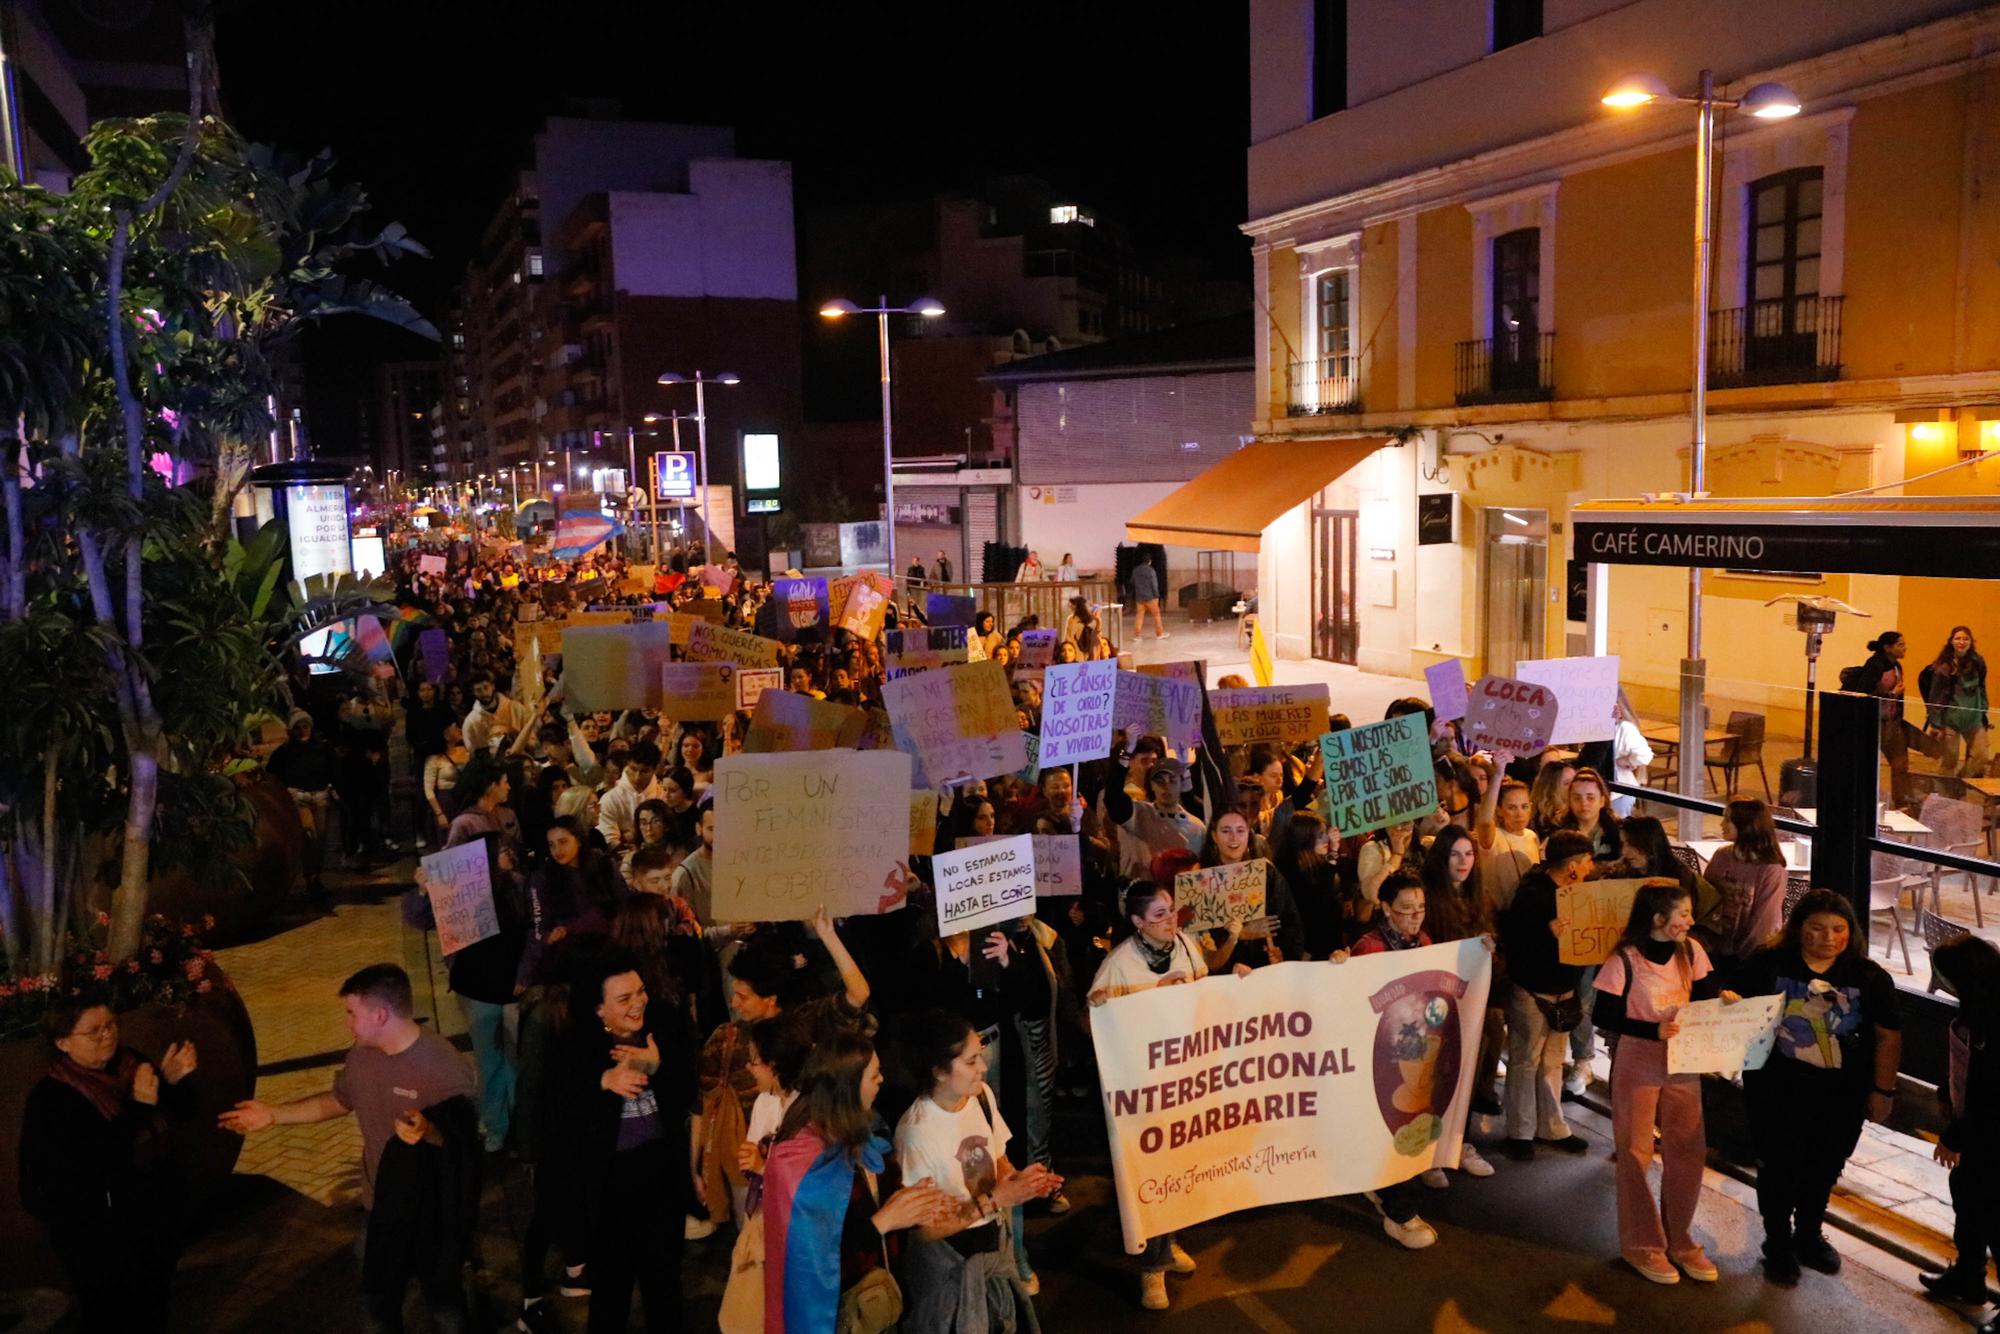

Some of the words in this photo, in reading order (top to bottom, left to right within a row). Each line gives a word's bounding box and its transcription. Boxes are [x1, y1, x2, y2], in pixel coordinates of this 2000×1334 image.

[316, 525, 336, 533] POR
[1591, 527, 1639, 555] CAFÉ
[1643, 532, 1765, 560] CAMERINO
[694, 624, 716, 641] NOS
[721, 632, 765, 653] QUERÉIS
[691, 641, 728, 660] COMO
[731, 651, 771, 669] MUSAS
[1051, 676, 1068, 698] ¿TE
[1071, 673, 1113, 695] CANSAS
[1272, 693, 1294, 705] ME
[1484, 680, 1545, 706] LOCA
[1053, 700, 1066, 715] DE
[1225, 710, 1250, 724] LAS
[1256, 706, 1312, 721] MUJERES
[1043, 712, 1110, 738] NOSOTRAS
[1240, 726, 1280, 738] VIOLO
[1287, 723, 1309, 737] 8M
[1325, 735, 1345, 759] SI
[1351, 719, 1412, 753] NOSOTRAS
[1475, 733, 1494, 744] MI
[1046, 742, 1059, 758] DE
[1066, 735, 1103, 755] VIVIRLO
[1329, 755, 1368, 783] SOMOS
[1369, 748, 1394, 772] LAS
[722, 770, 771, 804] POR
[803, 773, 839, 799] UN
[1331, 780, 1361, 806] ¿POR
[1362, 771, 1382, 795] QUE
[1383, 764, 1413, 789] SOMOS
[754, 806, 895, 833] FEMINISMO
[1334, 804, 1362, 833] LAS
[1364, 795, 1386, 824] QUE
[942, 865, 959, 877] NO
[965, 850, 1016, 872] ESTAMOS
[735, 876, 747, 898] Y
[764, 867, 870, 901] OBRERO
[949, 874, 984, 892] LOCAS
[989, 864, 1032, 883] ESTAMOS
[944, 895, 980, 919] HASTA
[982, 893, 998, 907] EL
[1001, 885, 1032, 901] COÑO
[1148, 1010, 1313, 1070] FEMINISMO
[1139, 1126, 1164, 1154] O
[1169, 1091, 1318, 1150] BARBARIE
[1137, 1174, 1182, 1205] Cafés
[1183, 1153, 1253, 1195] Feministas
[1254, 1144, 1318, 1175] Almería
